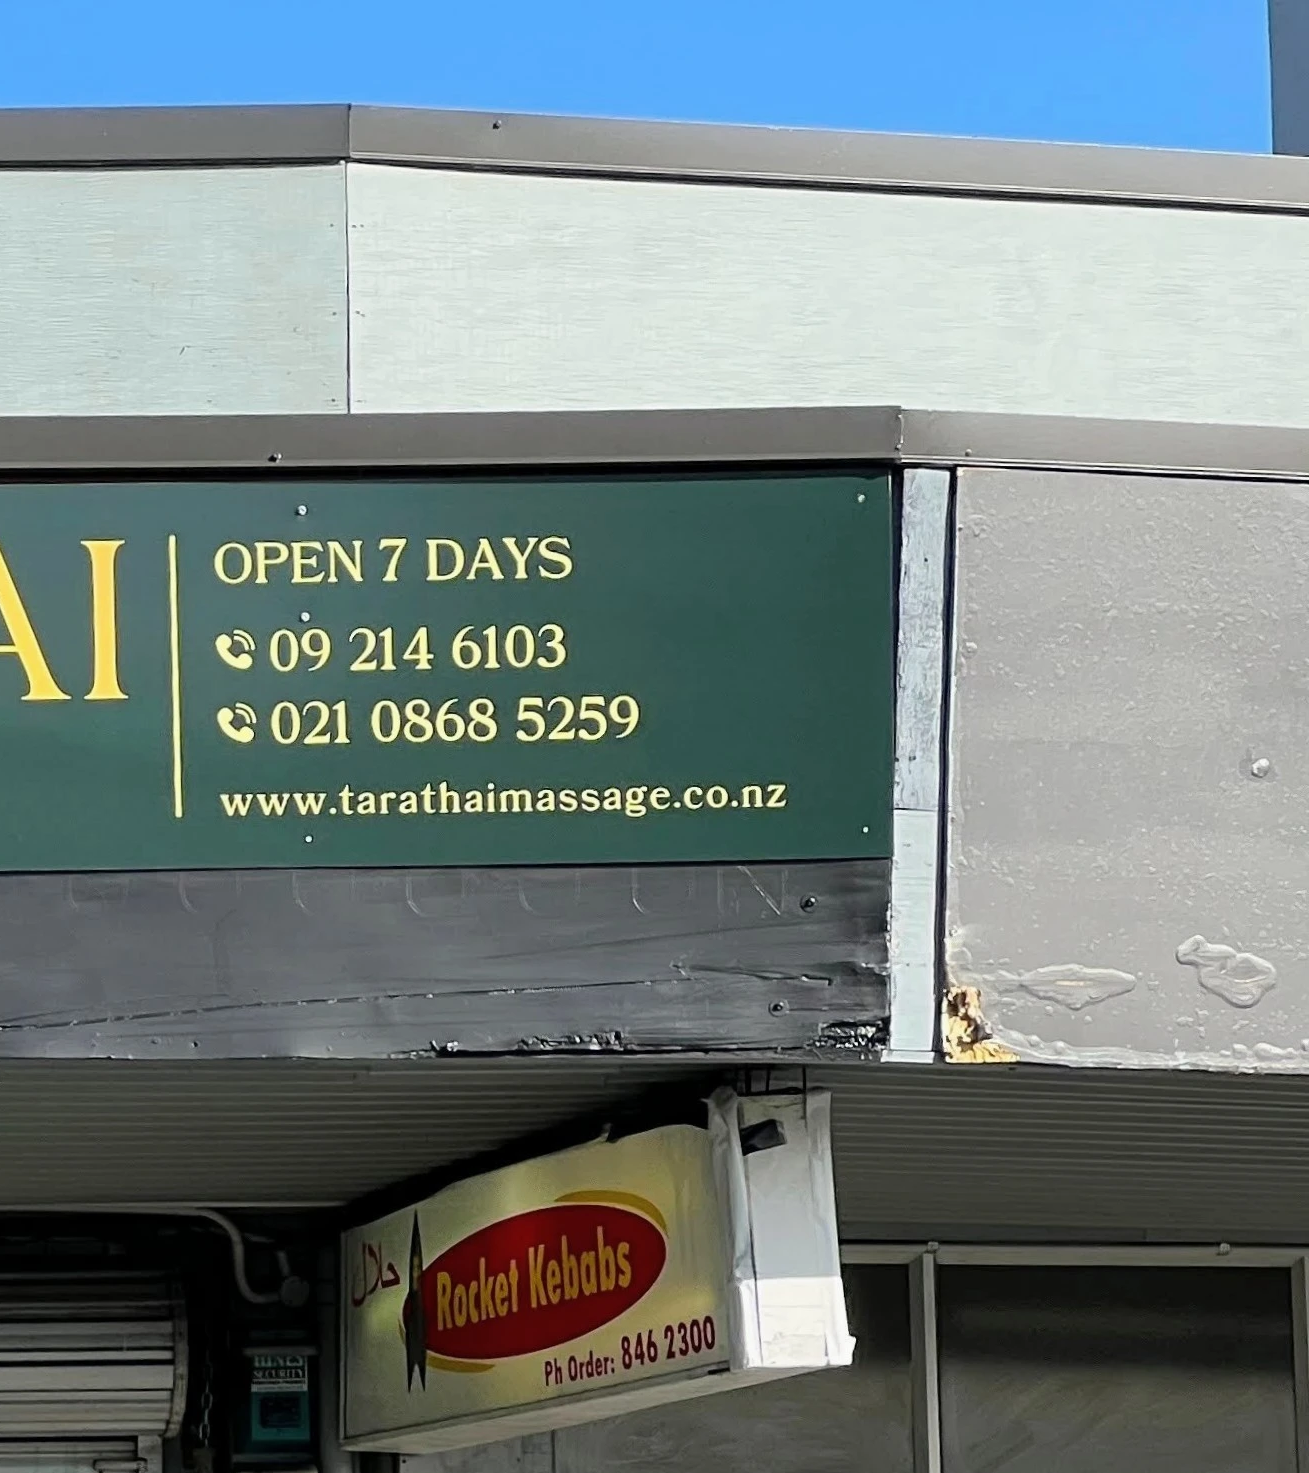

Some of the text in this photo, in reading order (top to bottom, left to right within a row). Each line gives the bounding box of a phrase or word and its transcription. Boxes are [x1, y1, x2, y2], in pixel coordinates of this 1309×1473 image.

[214, 536, 574, 585] OPEN 7 DAYS
[269, 622, 567, 673] 09 214 6103
[270, 695, 641, 745] 021 0868 5259
[220, 782, 788, 819] www.tarathaimassage.co.nz
[436, 1225, 632, 1332] Rocket Kebabs
[544, 1315, 717, 1387] Ph Order: 846 2300
